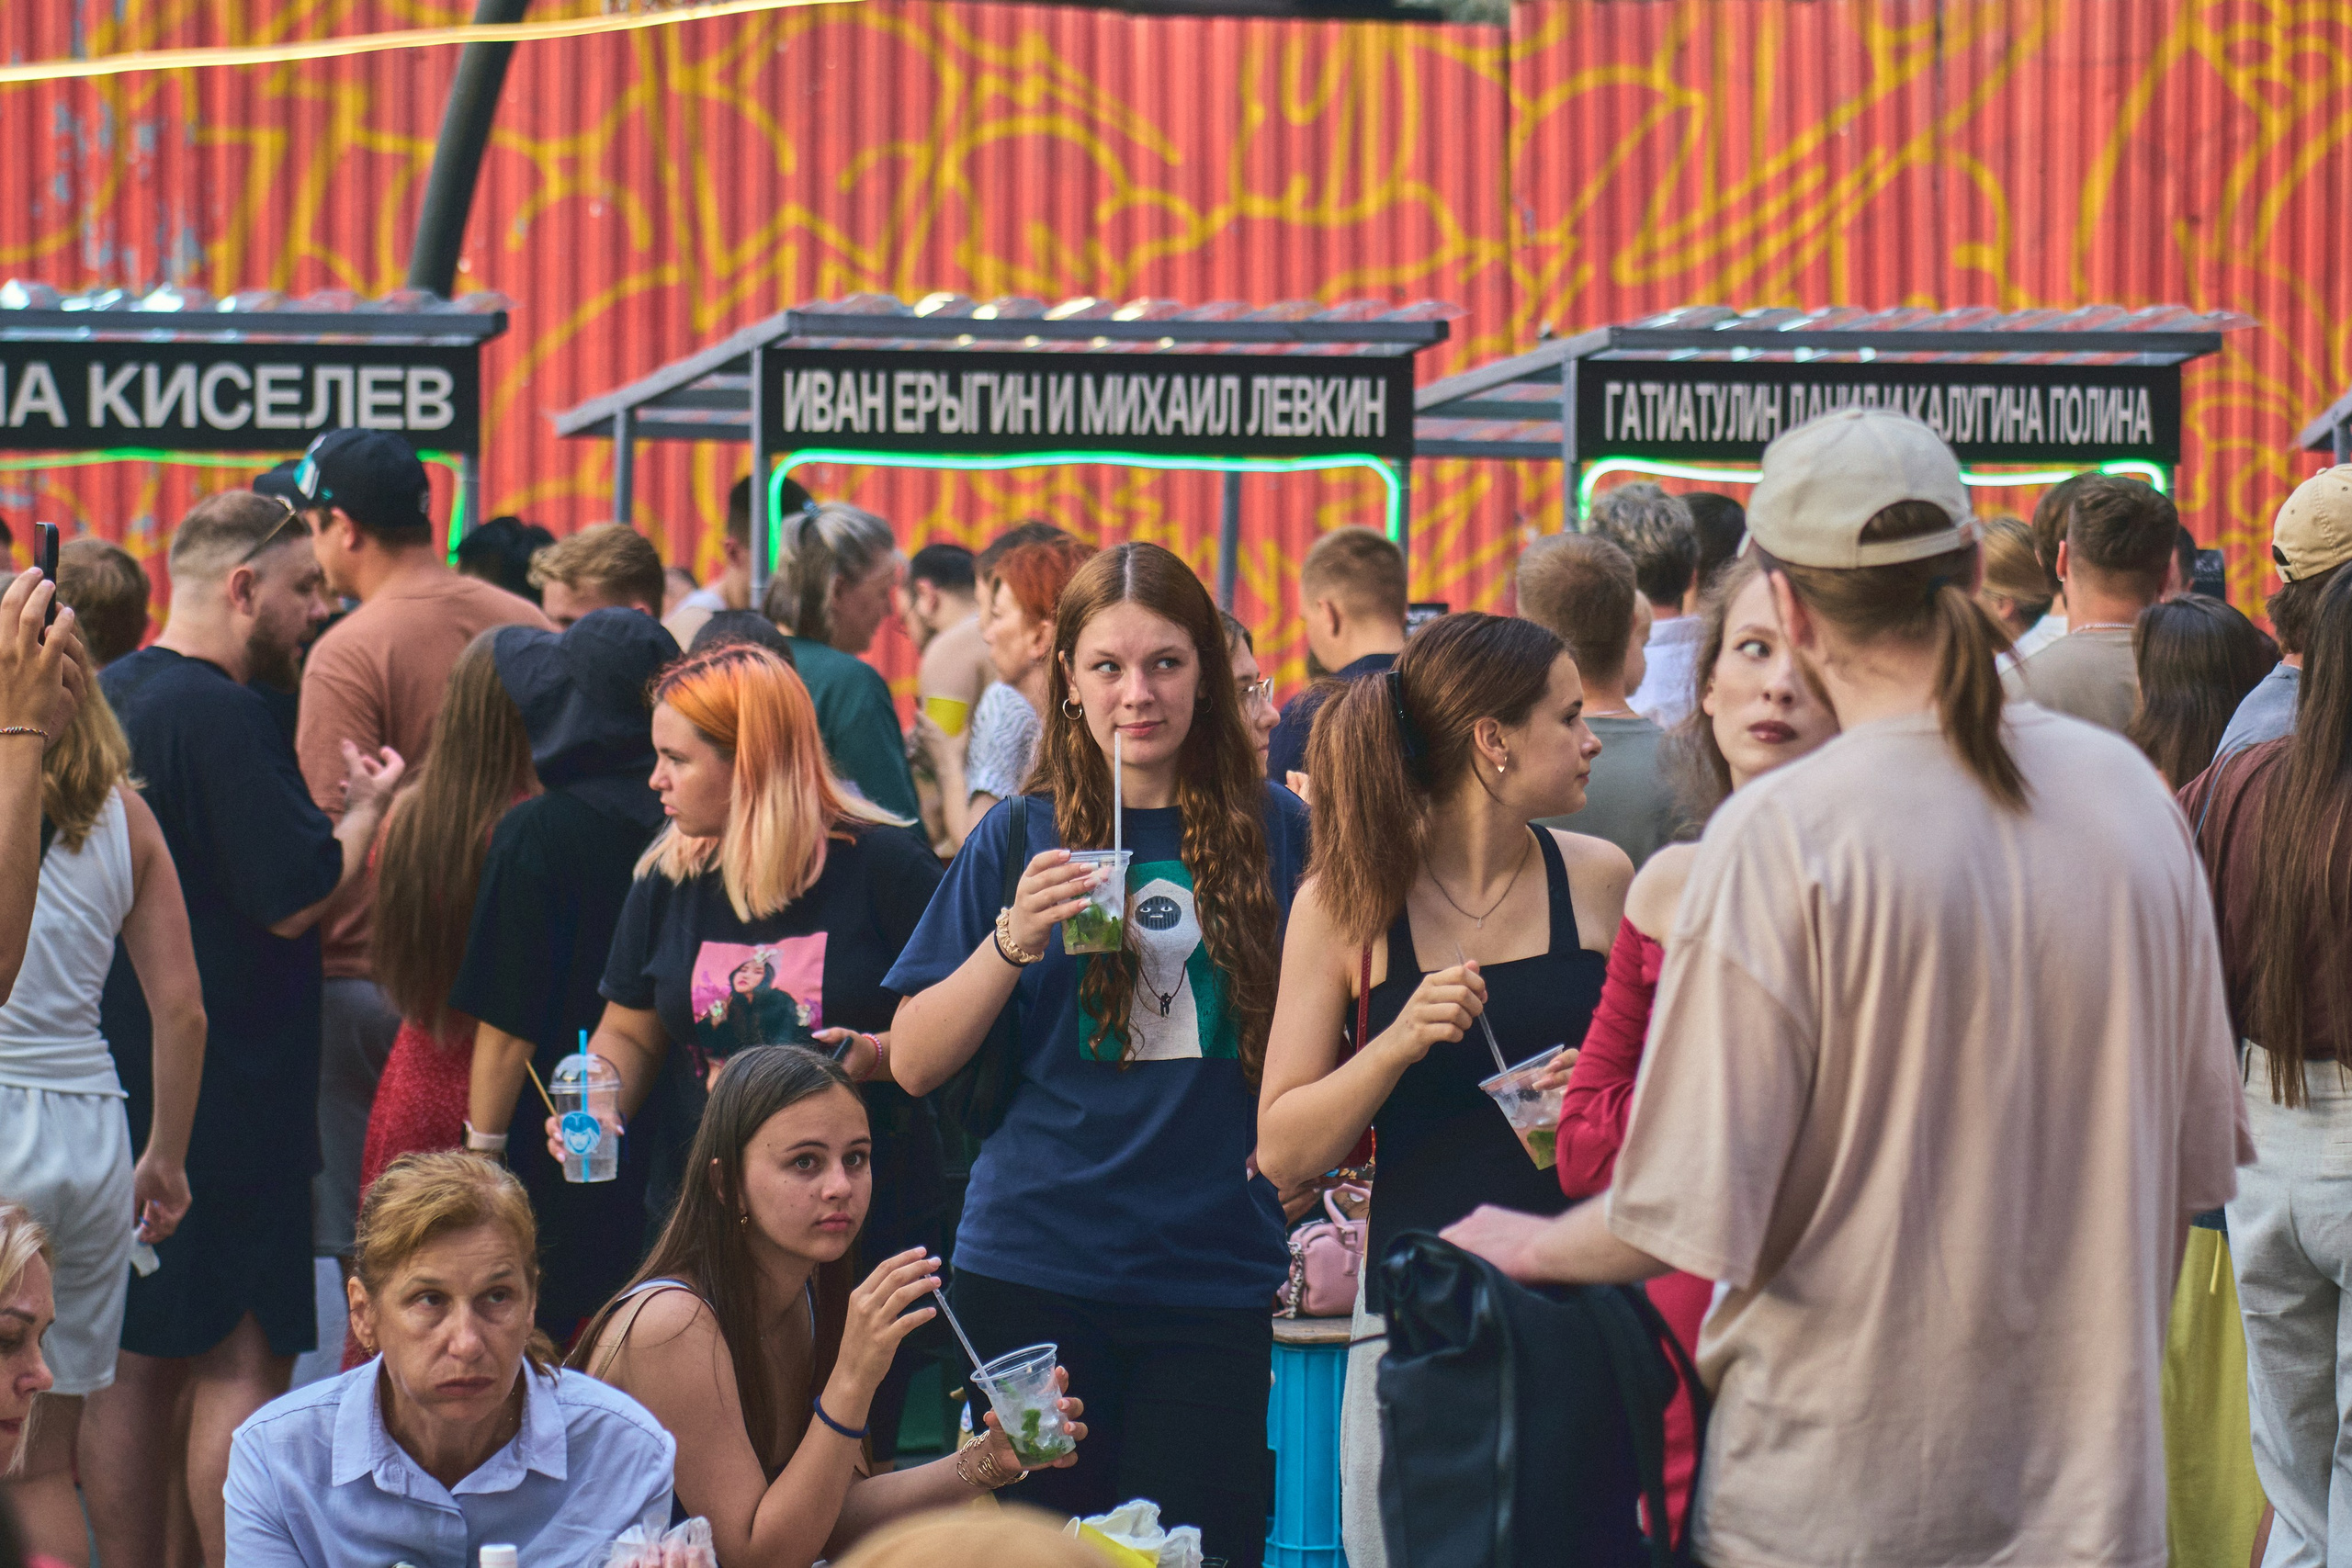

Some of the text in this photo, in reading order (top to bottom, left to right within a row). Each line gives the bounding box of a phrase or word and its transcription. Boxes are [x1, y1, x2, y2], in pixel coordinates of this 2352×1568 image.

[0, 362, 455, 430] А КИСЕЛЕВ
[783, 369, 1386, 438] ИВАН ЕРЫГИН И МИХАИЛ ЛЕВКИН
[1605, 381, 1781, 442] ГАТИАТУЛИН
[2049, 386, 2154, 446] ПОЛИНА
